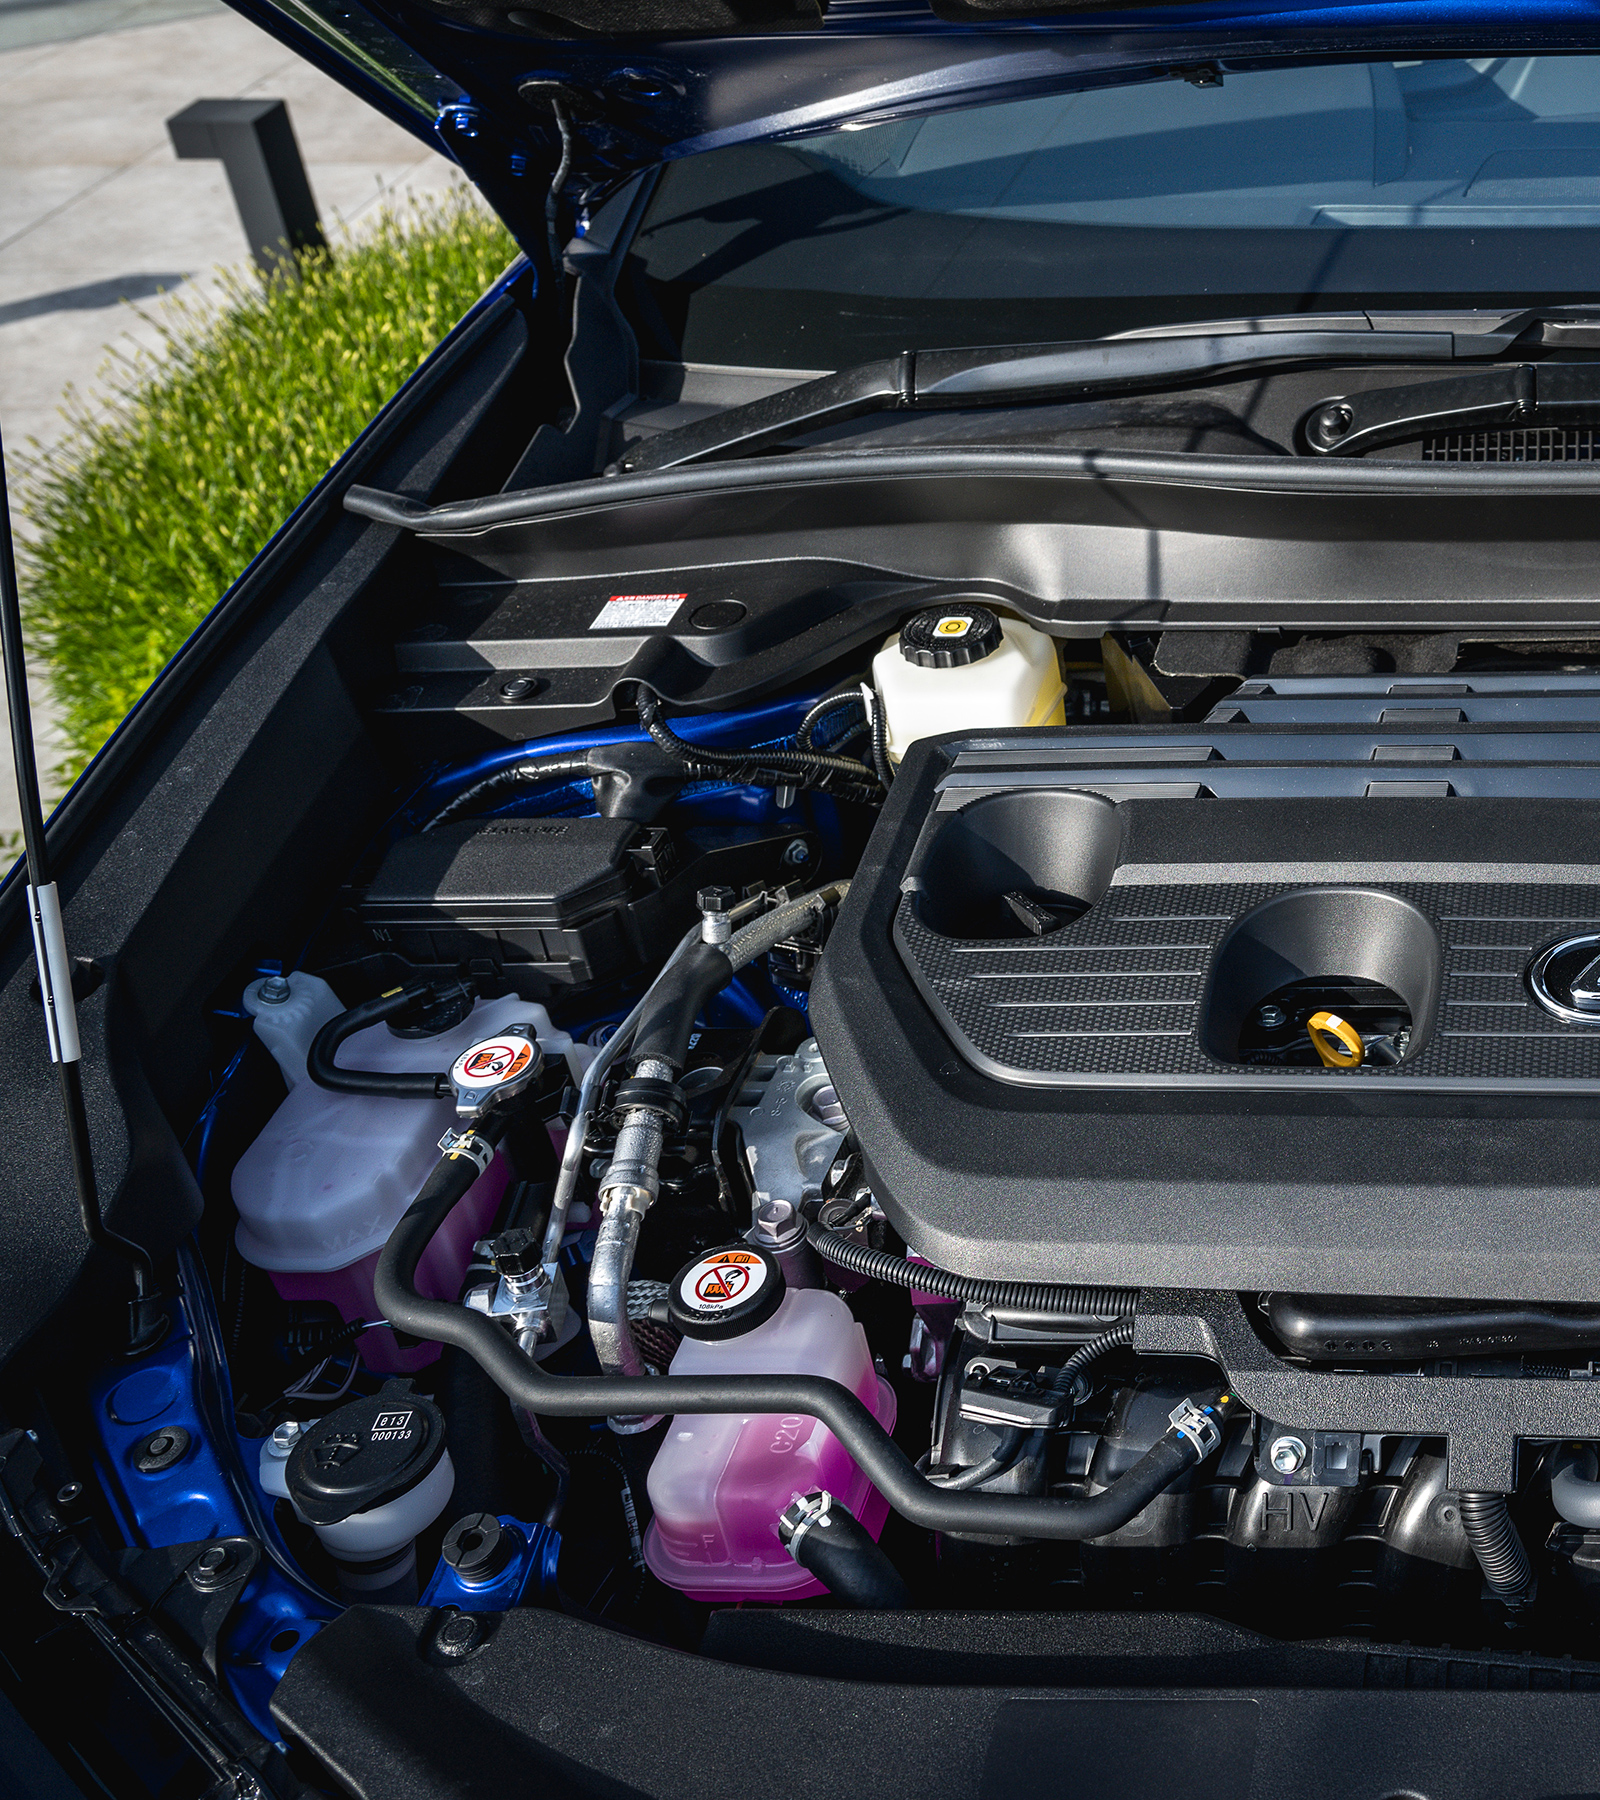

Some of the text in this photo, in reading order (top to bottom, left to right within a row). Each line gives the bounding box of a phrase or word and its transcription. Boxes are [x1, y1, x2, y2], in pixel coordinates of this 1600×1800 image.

[379, 1415, 406, 1427] e13
[370, 1429, 413, 1442] 000133
[1261, 1491, 1330, 1531] HV
